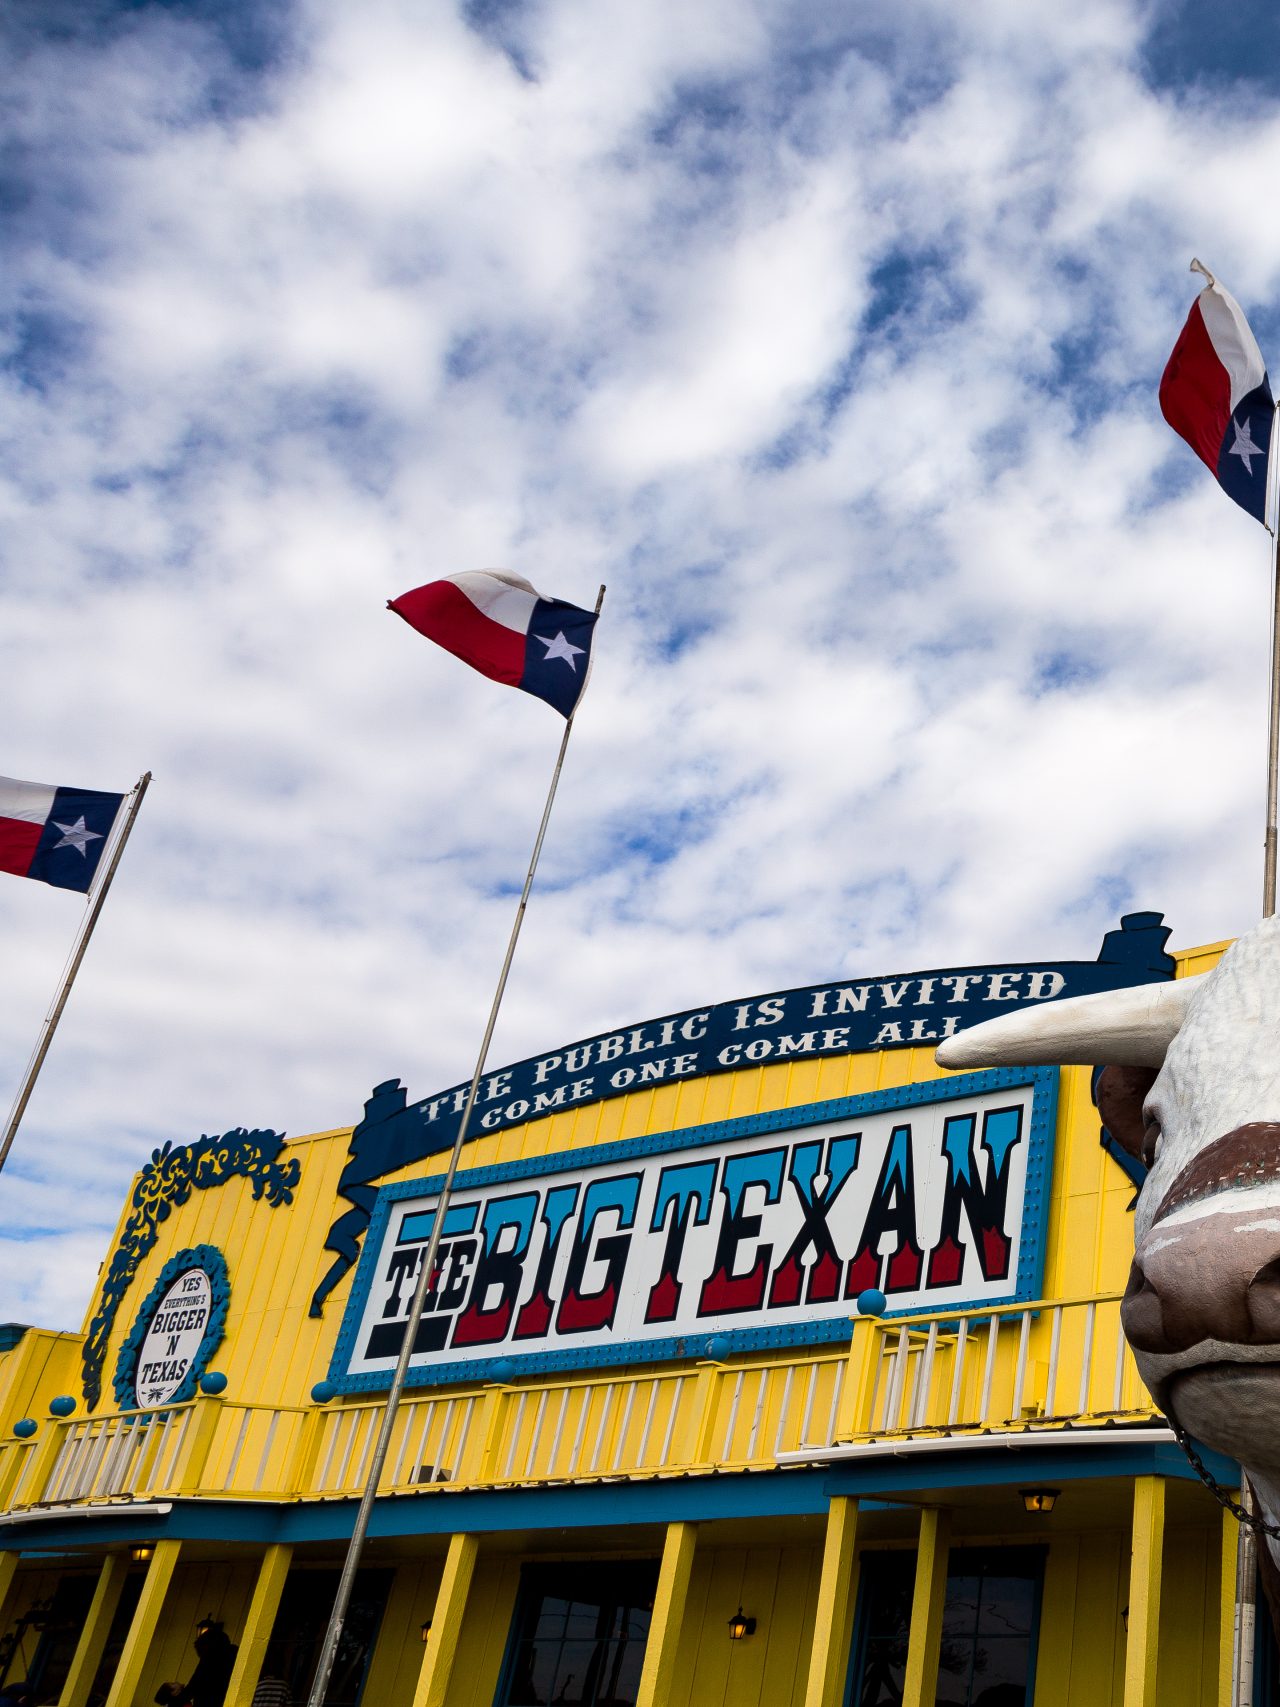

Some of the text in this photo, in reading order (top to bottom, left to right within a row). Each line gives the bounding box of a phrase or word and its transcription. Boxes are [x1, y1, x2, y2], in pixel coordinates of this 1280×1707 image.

[420, 971, 1066, 1125] THE PUBLIC IS INVITED
[480, 1076, 595, 1128] COME
[609, 1052, 698, 1088] ONE
[717, 1027, 851, 1066] COME
[382, 1104, 1023, 1349] THE BIG TEXAN
[181, 1277, 202, 1292] YES
[164, 1295, 206, 1309] EVERYTHING'S
[152, 1309, 206, 1334] BIGGER
[141, 1359, 188, 1384] TEXAS
